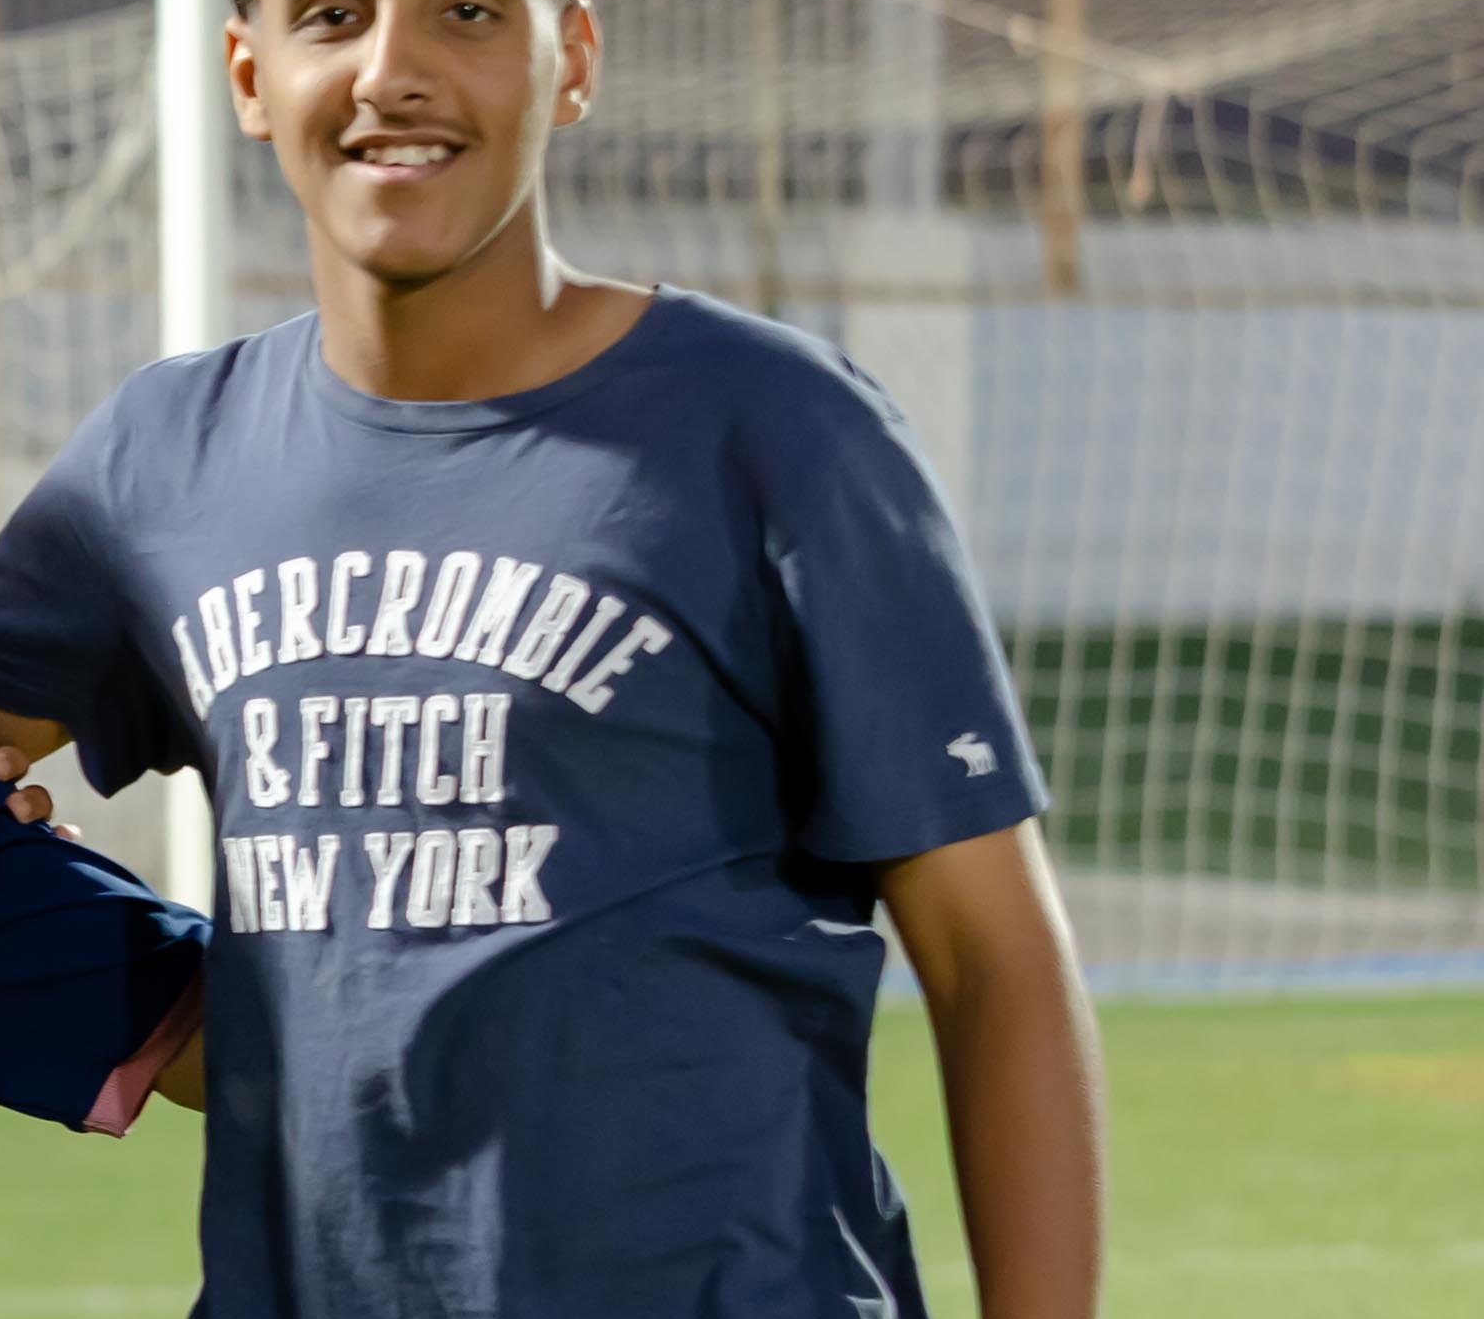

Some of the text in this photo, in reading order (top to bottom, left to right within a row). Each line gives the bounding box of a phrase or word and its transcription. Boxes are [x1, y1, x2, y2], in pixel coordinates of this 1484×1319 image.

[243, 693, 512, 809] & FITCH
[224, 824, 559, 932] NEW YORK
